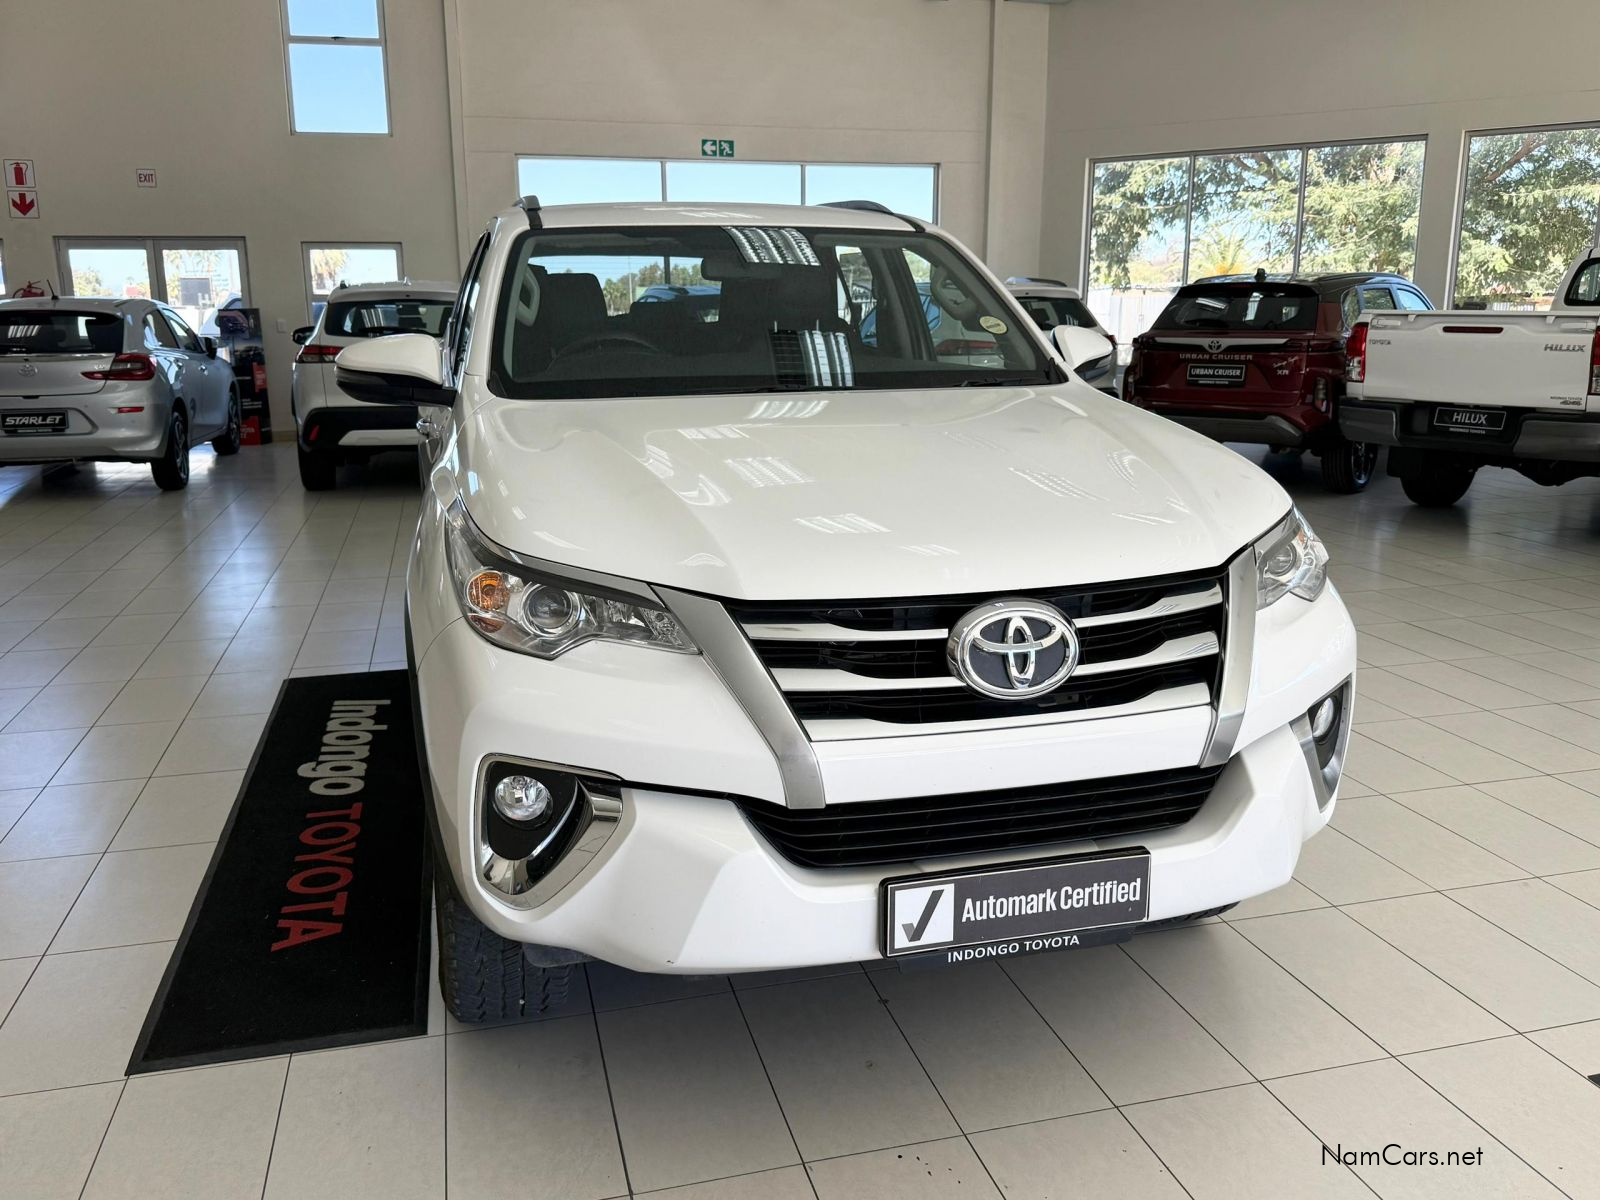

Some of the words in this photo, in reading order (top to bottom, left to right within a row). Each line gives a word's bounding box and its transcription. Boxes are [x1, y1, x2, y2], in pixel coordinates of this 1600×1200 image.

[139, 173, 154, 183] EXIT
[1544, 343, 1587, 353] HILUX
[1179, 353, 1210, 361] URBAN
[1191, 368, 1213, 376] URBAN
[1214, 368, 1241, 377] CRUISER
[4, 415, 63, 425] STARLET
[1452, 412, 1489, 425] HILUX
[297, 698, 391, 796] Indongo
[270, 801, 363, 953] TOYOTA
[961, 888, 1057, 923] Automark
[1059, 877, 1142, 909] Certified
[947, 942, 1020, 964] INDONGO
[1023, 934, 1080, 952] TOYOTA
